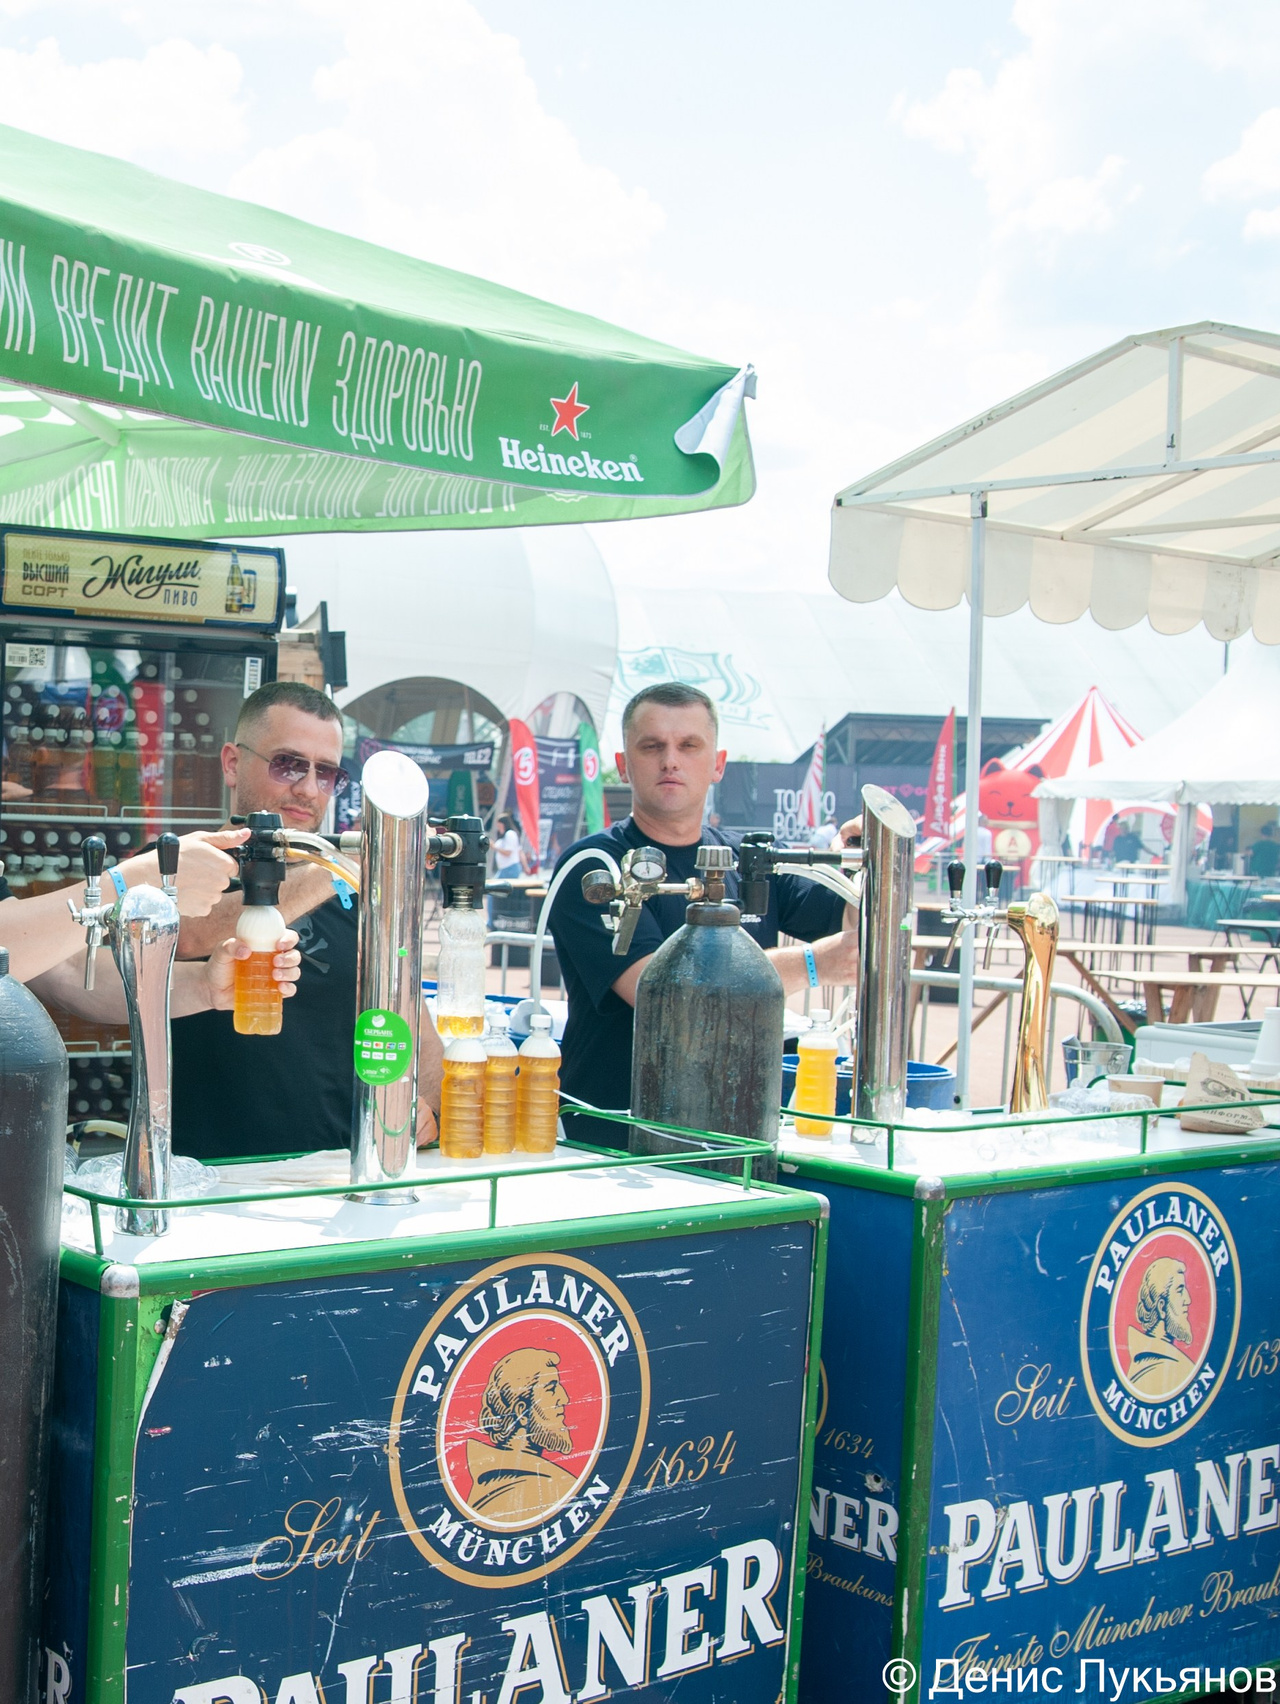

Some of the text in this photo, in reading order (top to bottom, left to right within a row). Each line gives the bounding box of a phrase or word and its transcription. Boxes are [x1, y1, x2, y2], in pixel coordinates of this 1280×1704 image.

[50, 254, 179, 396] ВРЕДИТ
[190, 295, 323, 429] ВАШЕМУ
[331, 330, 484, 462] ЗДОРОВЬЮ
[499, 437, 645, 483] Heineken
[21, 584, 69, 598] СОРТ
[22, 561, 70, 584] ВЫСШИЙ
[81, 554, 202, 600] Жигули
[163, 587, 198, 607] ПИВО
[1095, 1196, 1232, 1295] PAULANER
[412, 1270, 630, 1402] PAULANER
[994, 1362, 1080, 1427] Seit
[1102, 1360, 1217, 1431] MÜNCHEN
[823, 1427, 876, 1459] 1634
[252, 1429, 740, 1582] Seit 1634
[428, 1474, 612, 1566] MÜNCHEN
[1049, 1596, 1193, 1659] Münchner
